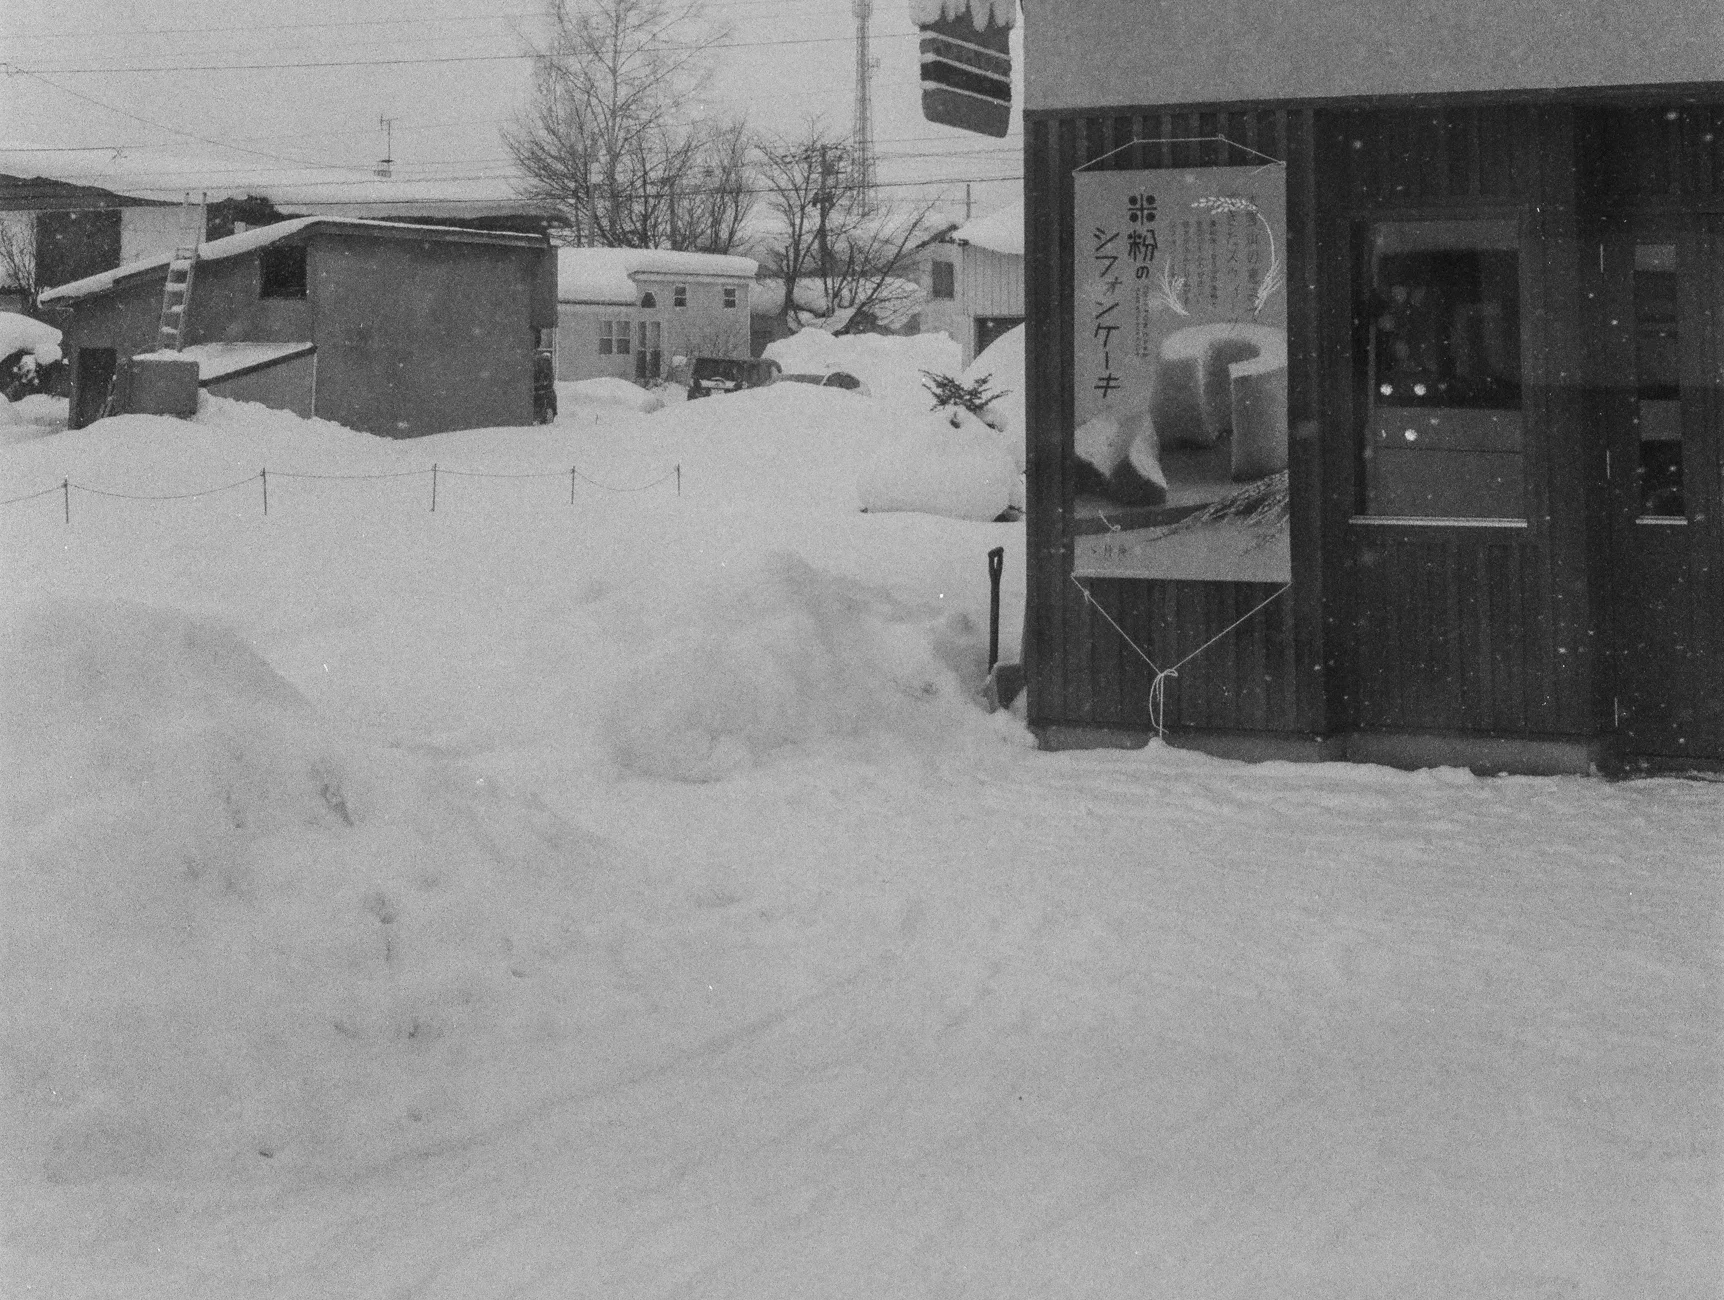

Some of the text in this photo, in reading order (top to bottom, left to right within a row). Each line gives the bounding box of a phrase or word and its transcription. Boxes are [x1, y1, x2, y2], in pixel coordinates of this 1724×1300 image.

[1127, 193, 1158, 280] 米粉の
[1093, 227, 1123, 399] シフォンケーキ
